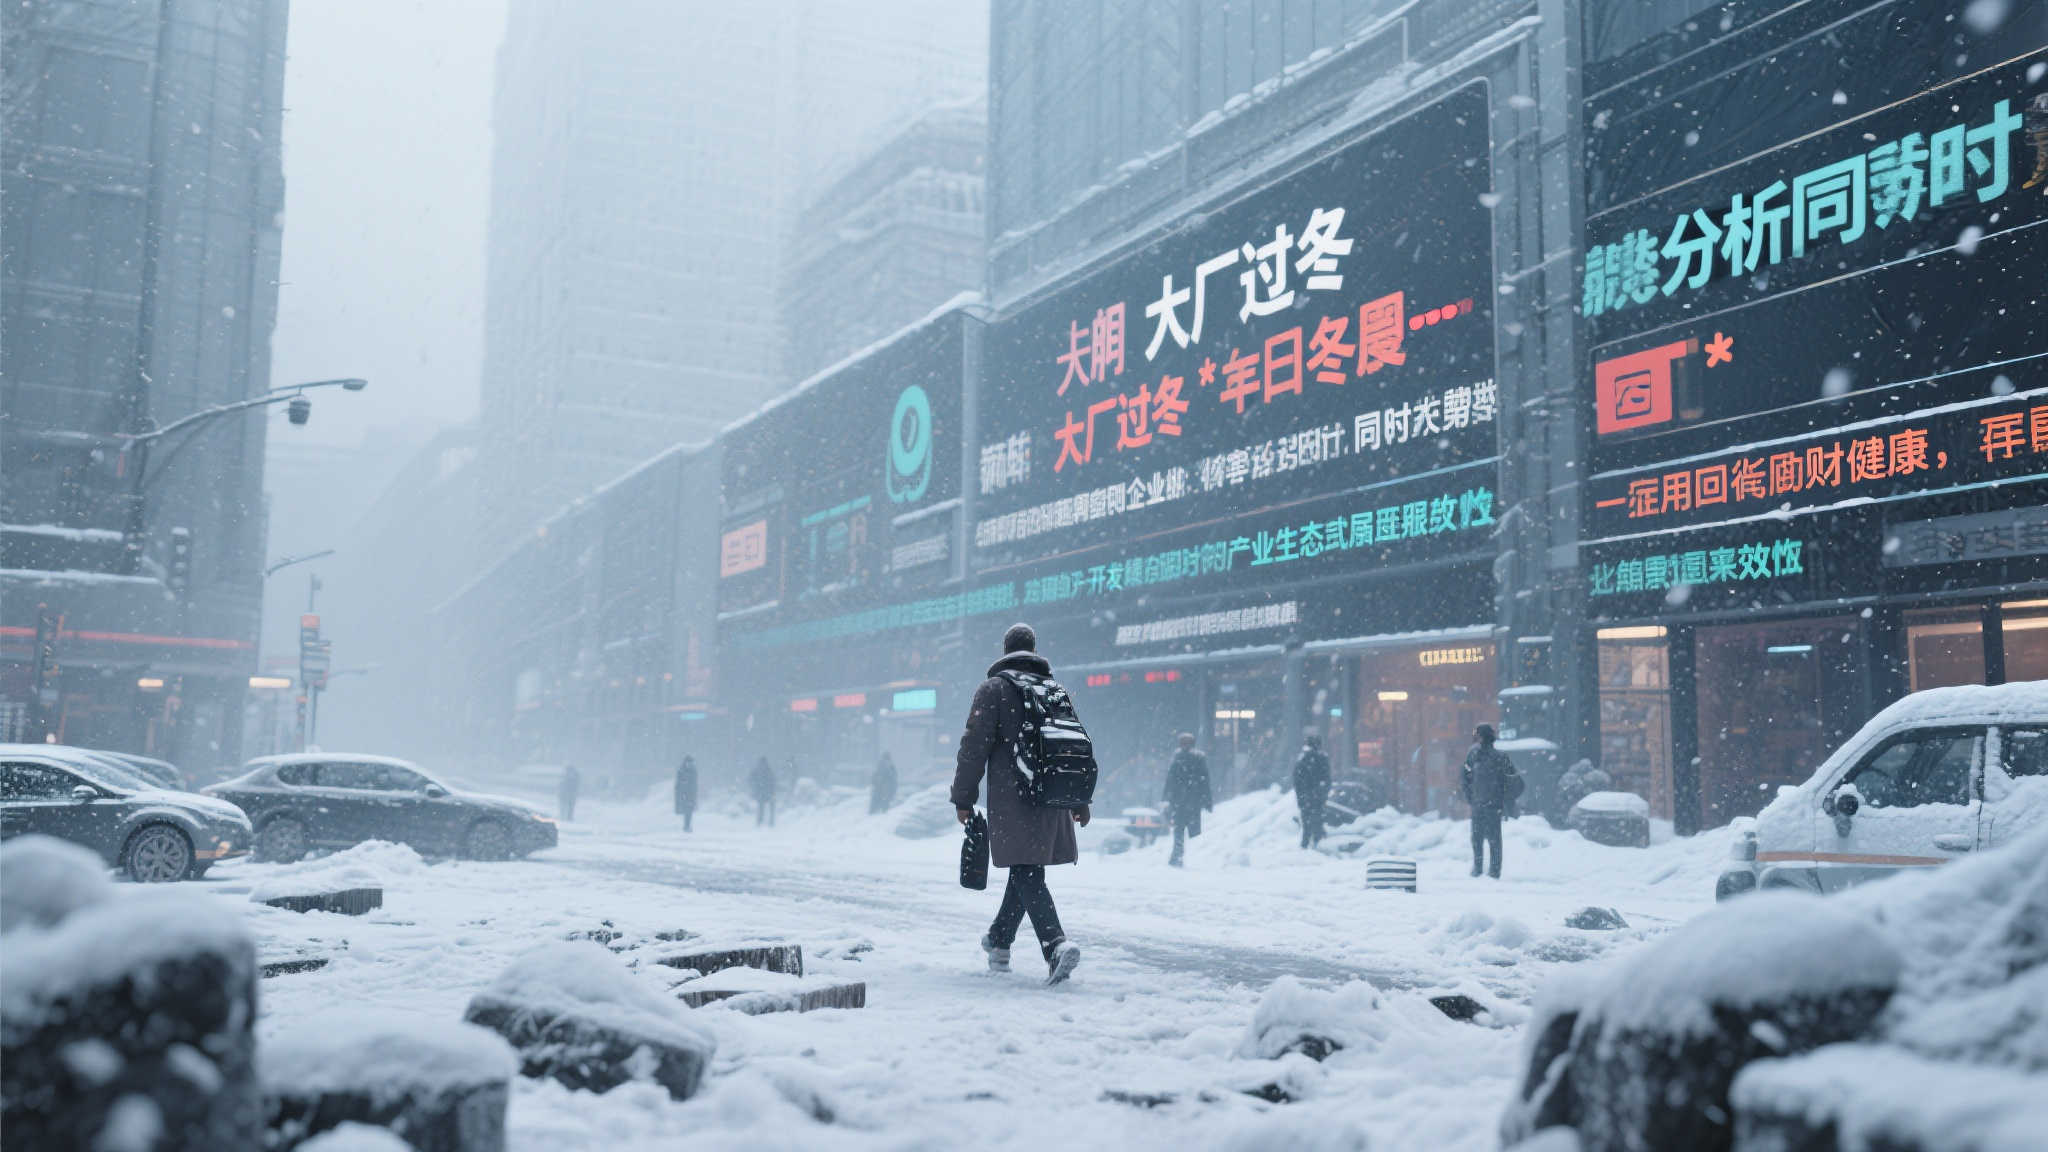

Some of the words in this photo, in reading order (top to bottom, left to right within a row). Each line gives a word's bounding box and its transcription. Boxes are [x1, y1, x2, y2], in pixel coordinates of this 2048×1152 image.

[1145, 207, 1355, 362] 大厂过冬
[1054, 374, 1190, 473] 大厂过冬
